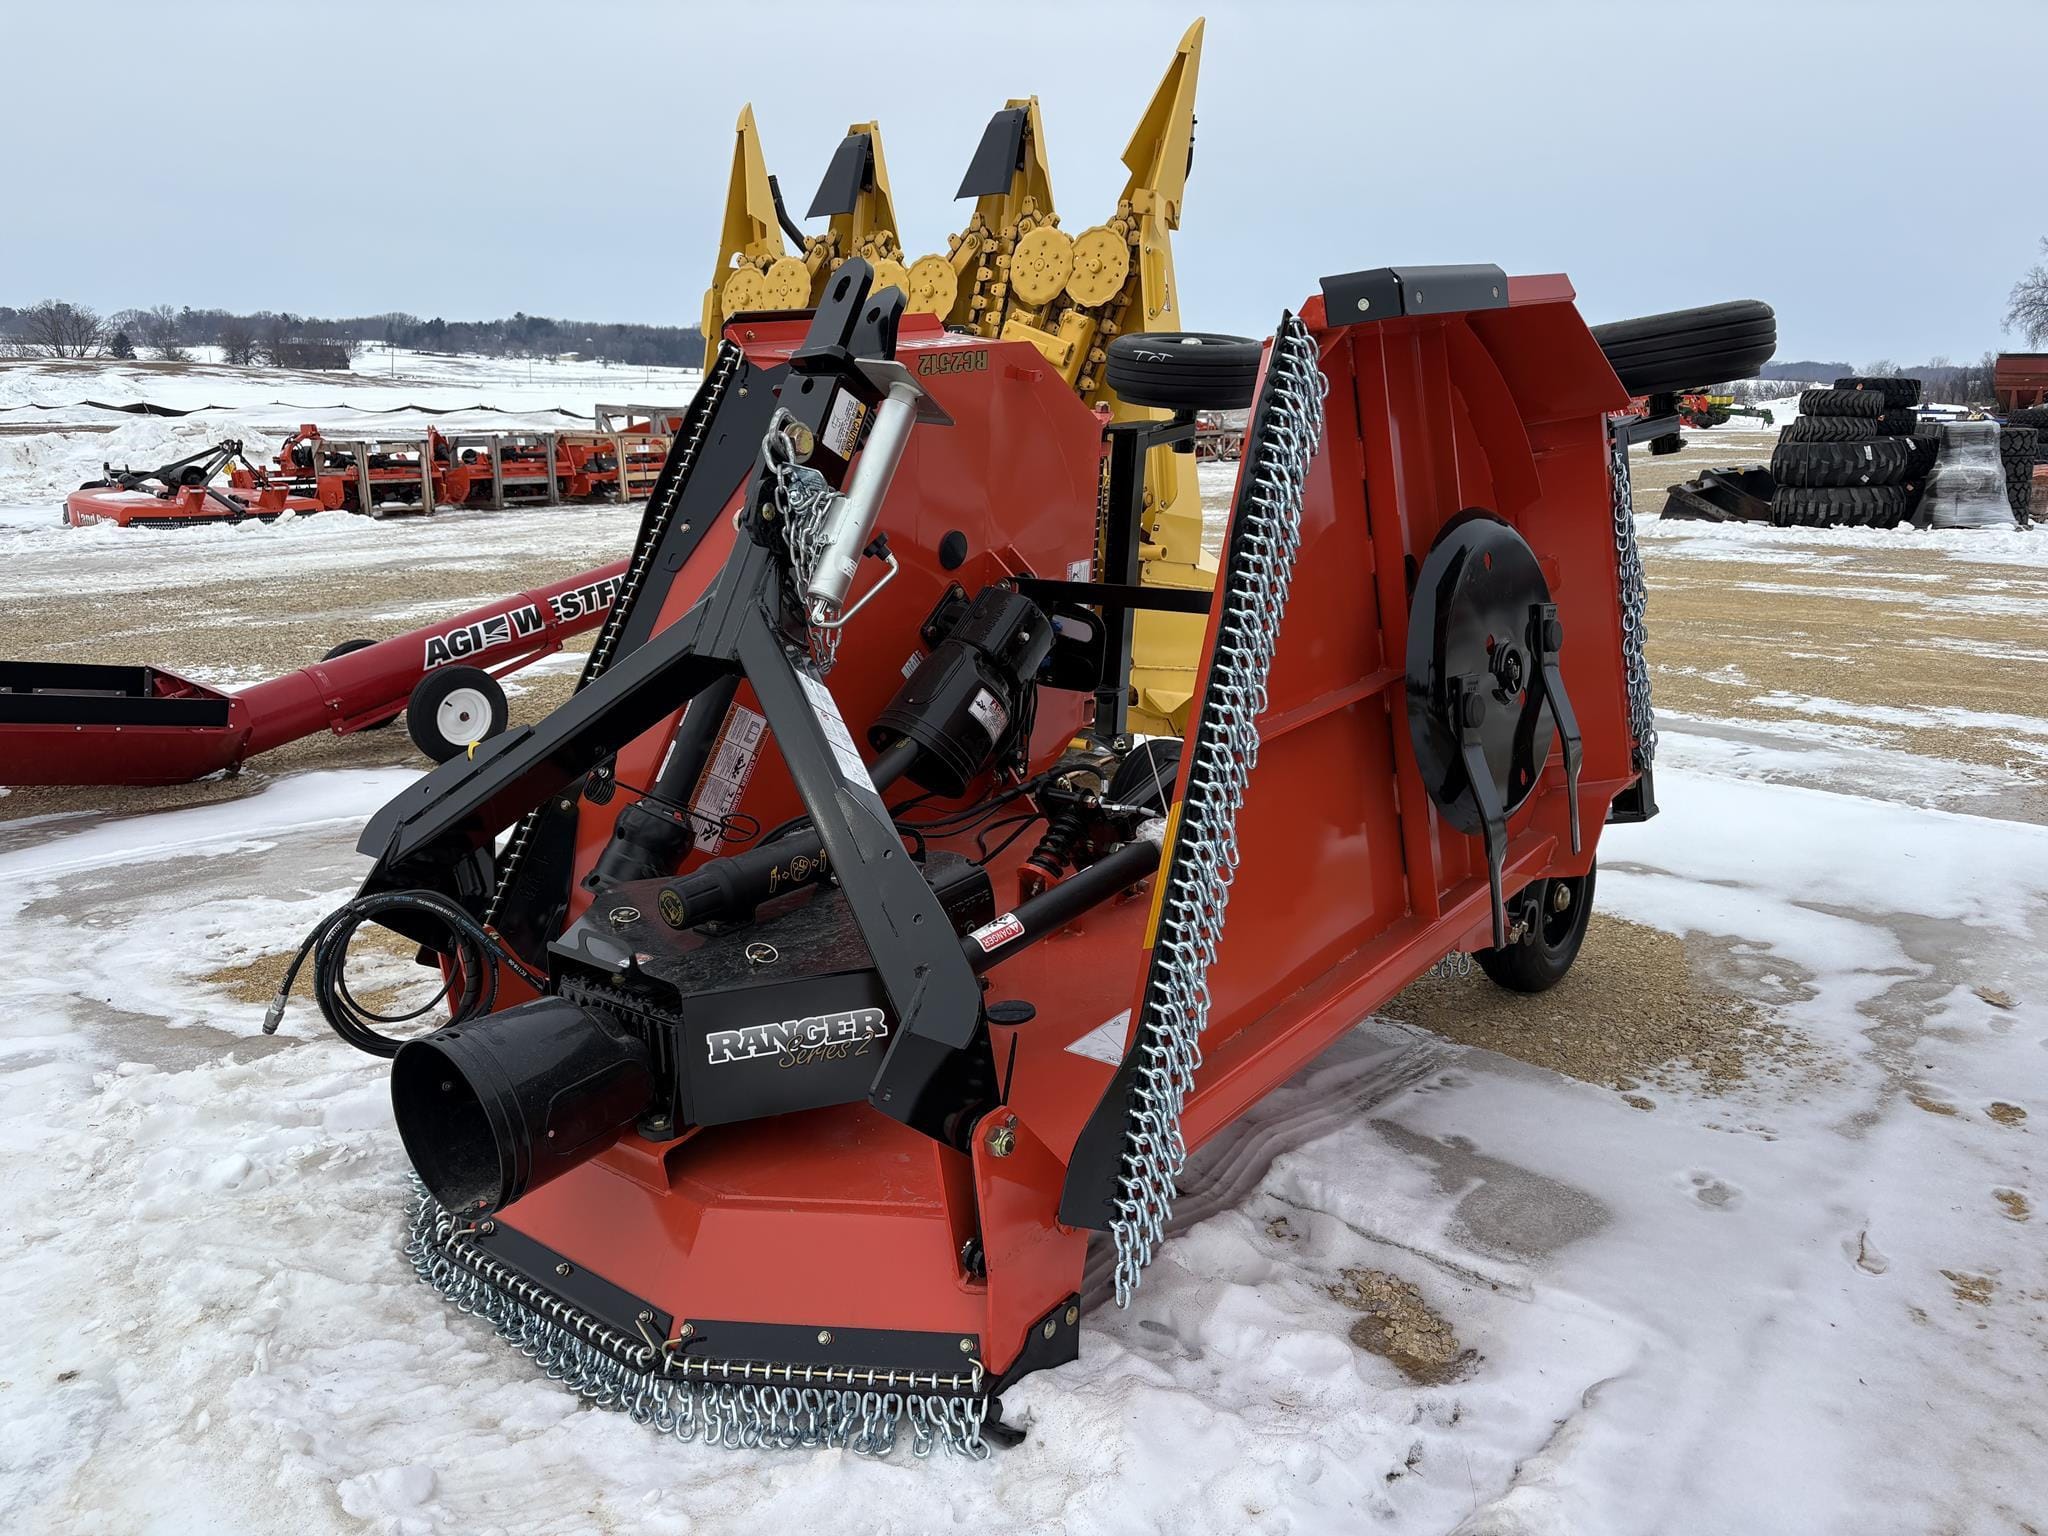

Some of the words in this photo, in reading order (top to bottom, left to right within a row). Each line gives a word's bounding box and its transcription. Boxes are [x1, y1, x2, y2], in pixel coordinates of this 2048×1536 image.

[918, 350, 988, 376] RC2512
[845, 420, 860, 453] CAUTION
[424, 624, 483, 671] AGI
[510, 573, 626, 638] WESTFI
[982, 927, 1012, 947] DANGER
[706, 1007, 888, 1064] RANGER
[778, 1034, 852, 1068] Series
[855, 1030, 876, 1056] 2
